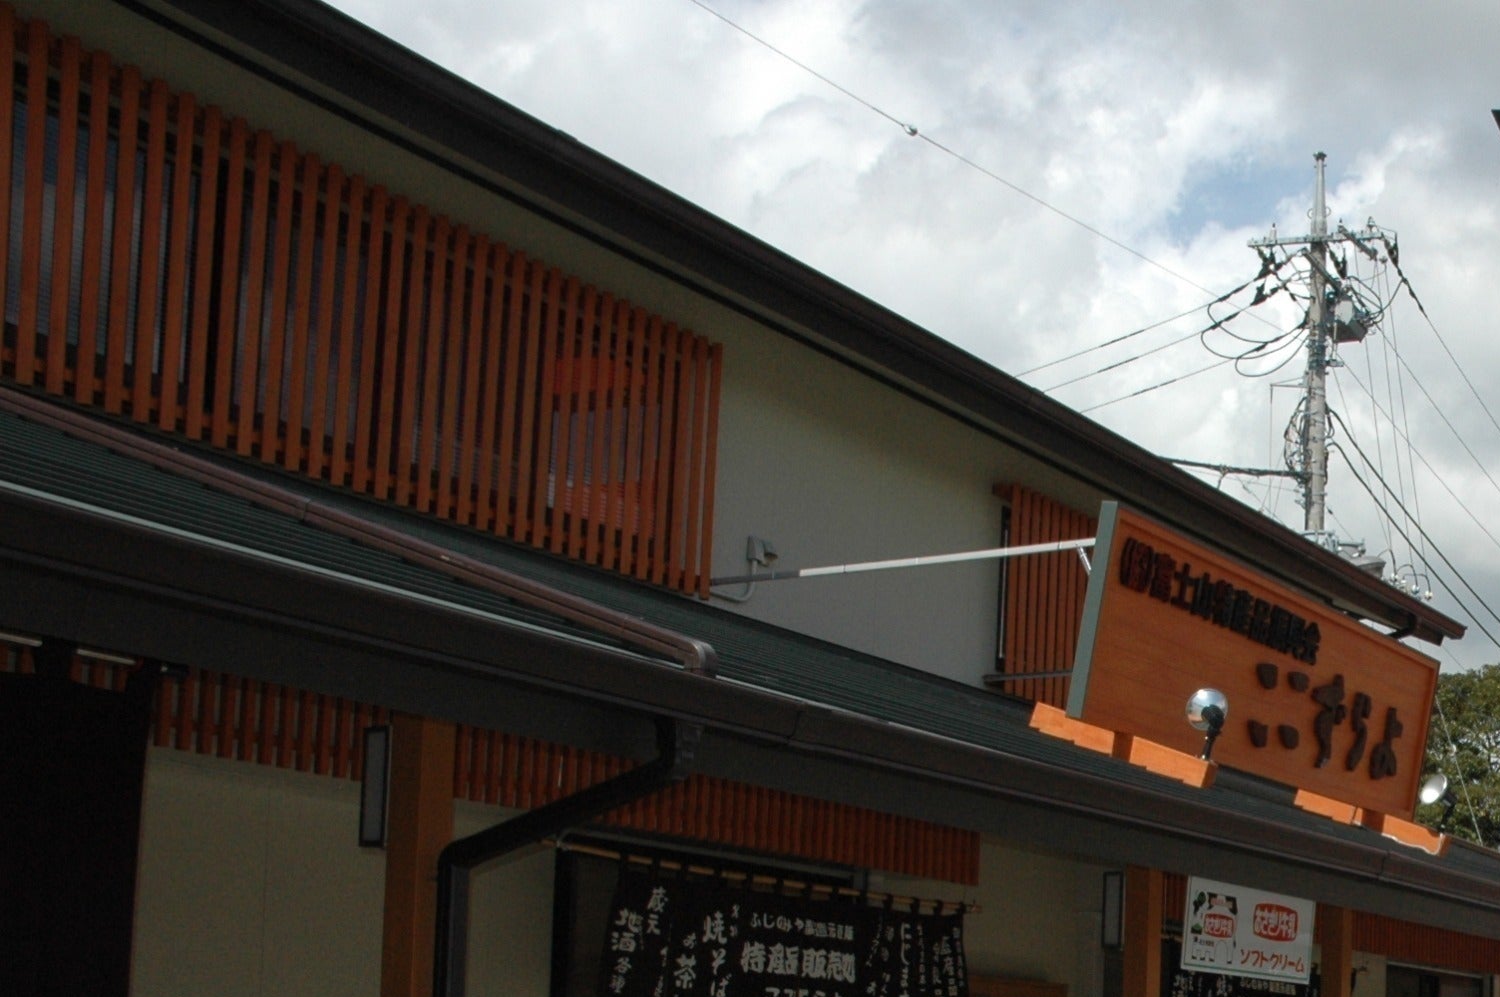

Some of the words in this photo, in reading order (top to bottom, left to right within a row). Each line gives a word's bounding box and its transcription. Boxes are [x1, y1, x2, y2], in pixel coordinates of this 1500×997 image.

[1240, 949, 1305, 973] ソフトクリーム
